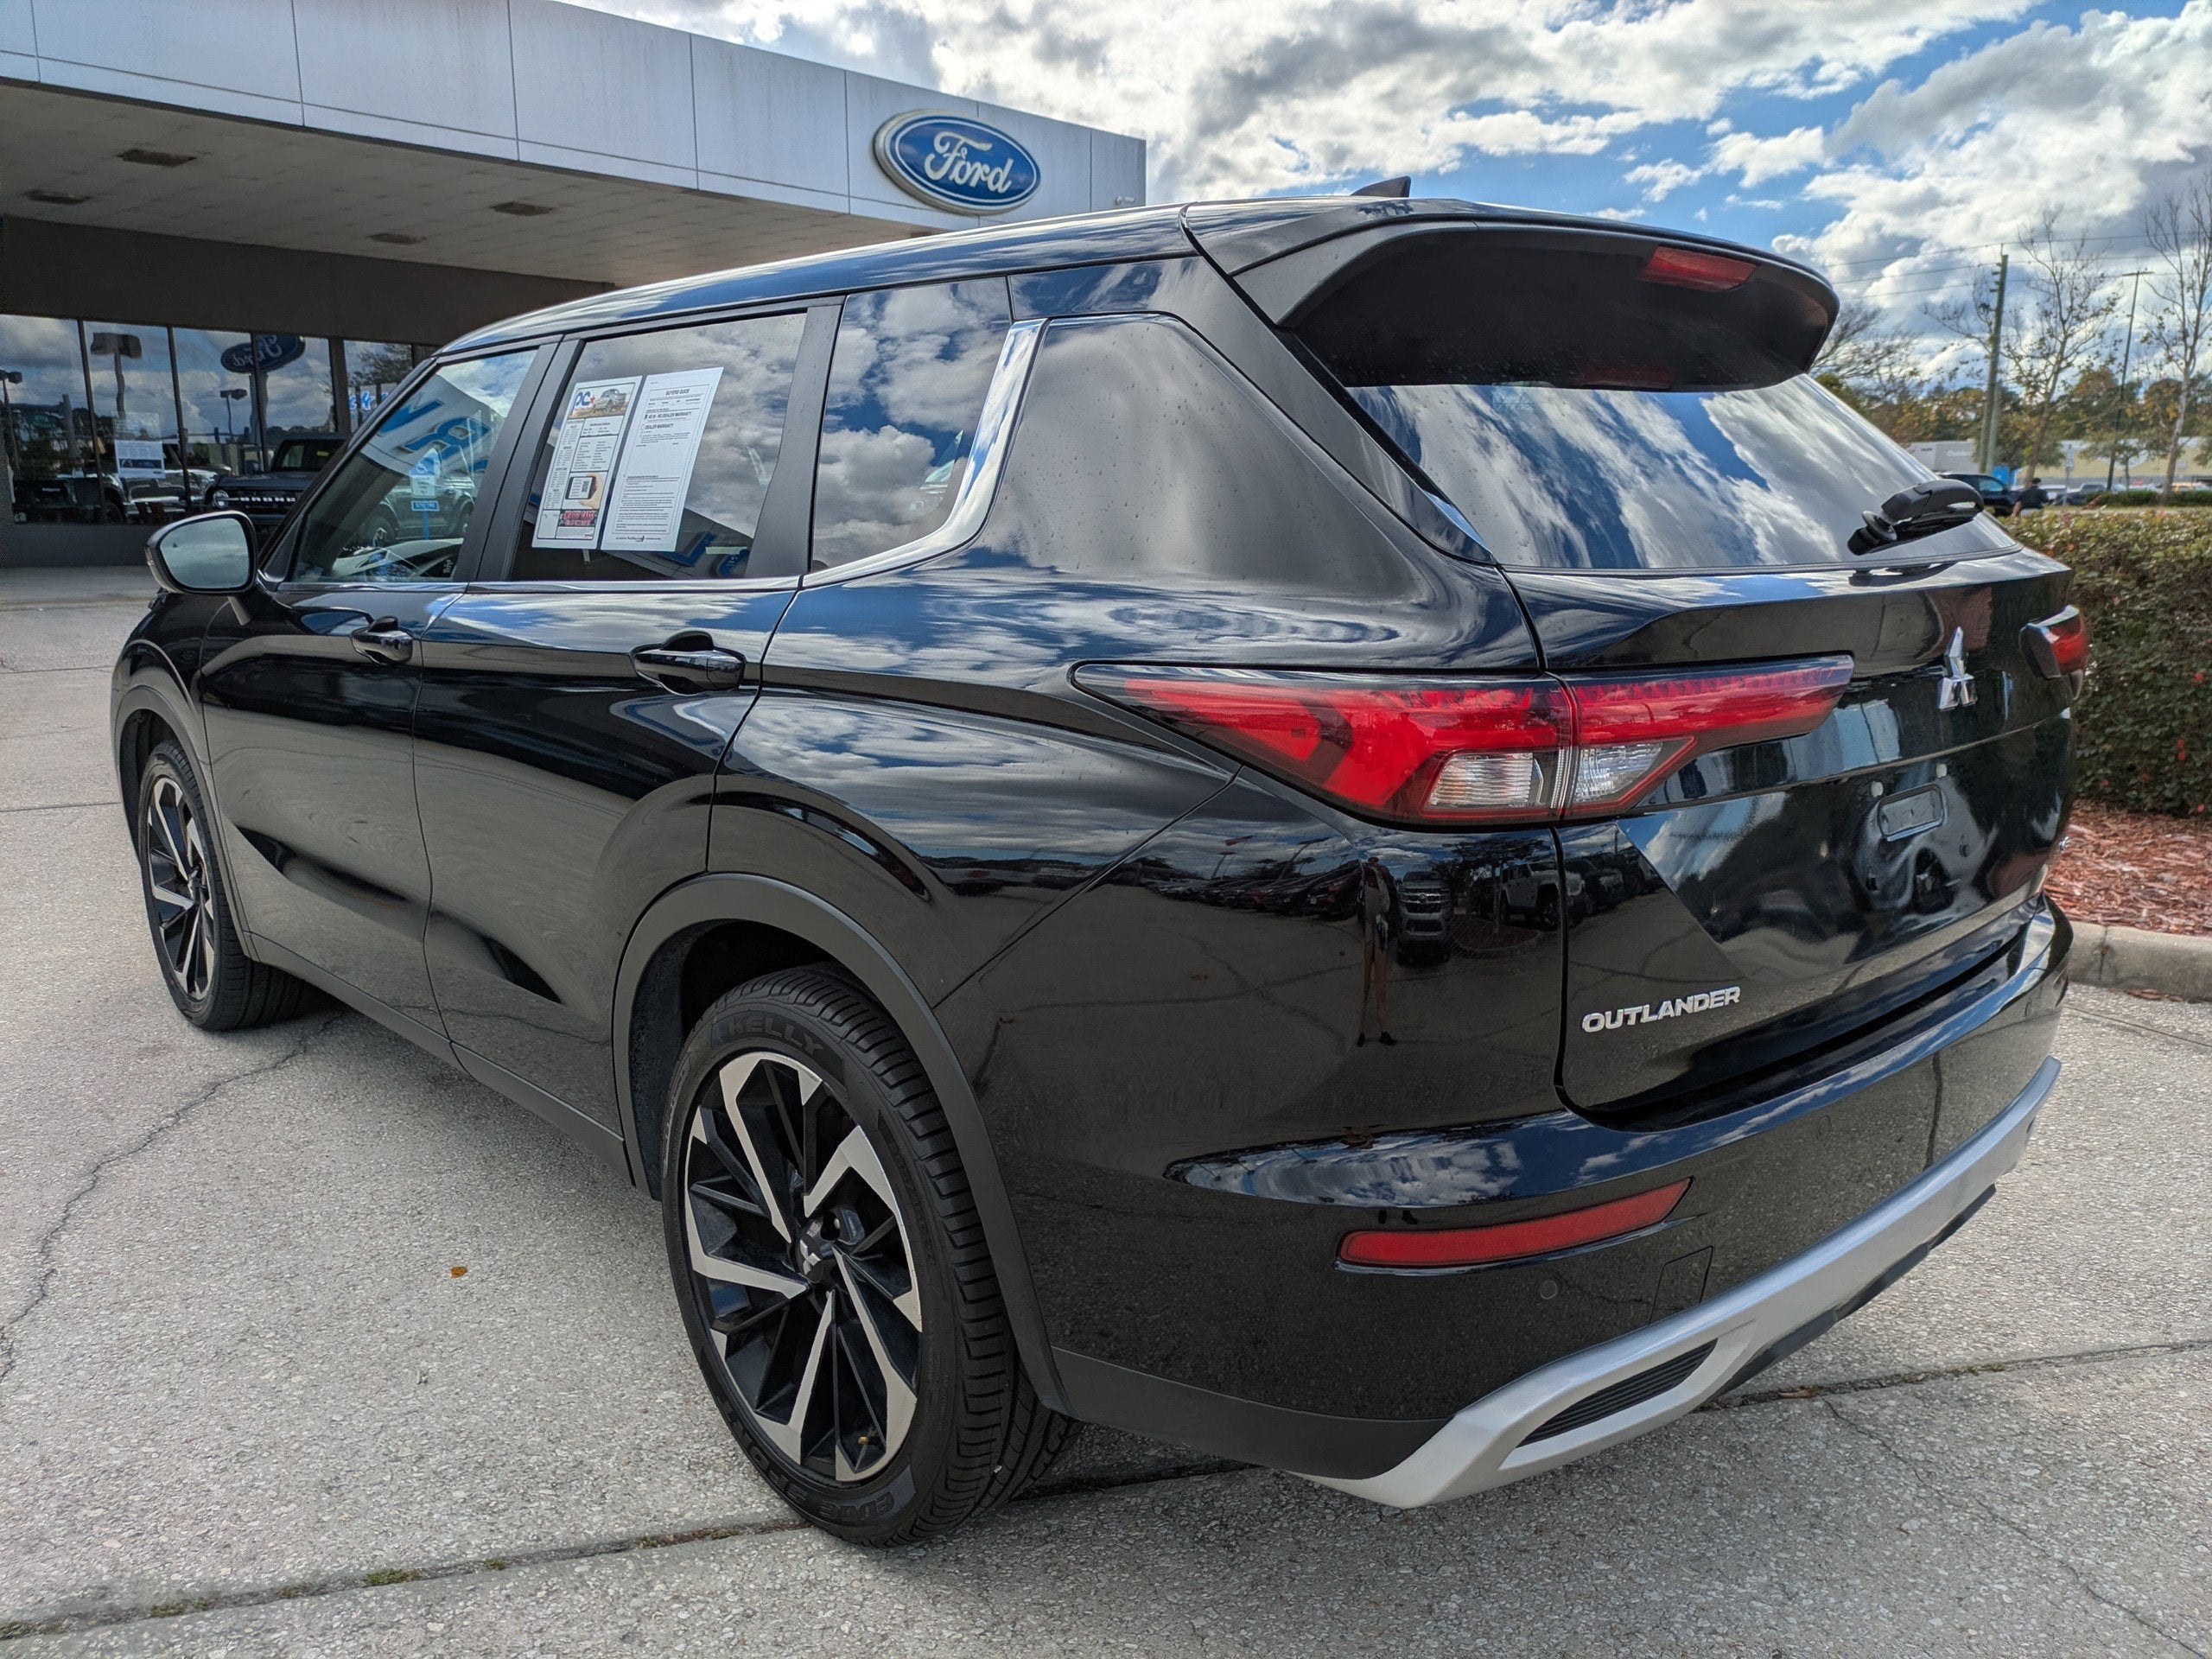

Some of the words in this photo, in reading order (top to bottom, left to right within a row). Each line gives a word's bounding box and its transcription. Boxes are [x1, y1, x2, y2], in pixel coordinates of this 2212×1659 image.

[924, 130, 1014, 194] Ford
[1582, 986, 1741, 1033] OUTLANDER
[728, 1015, 825, 1056] KELLY
